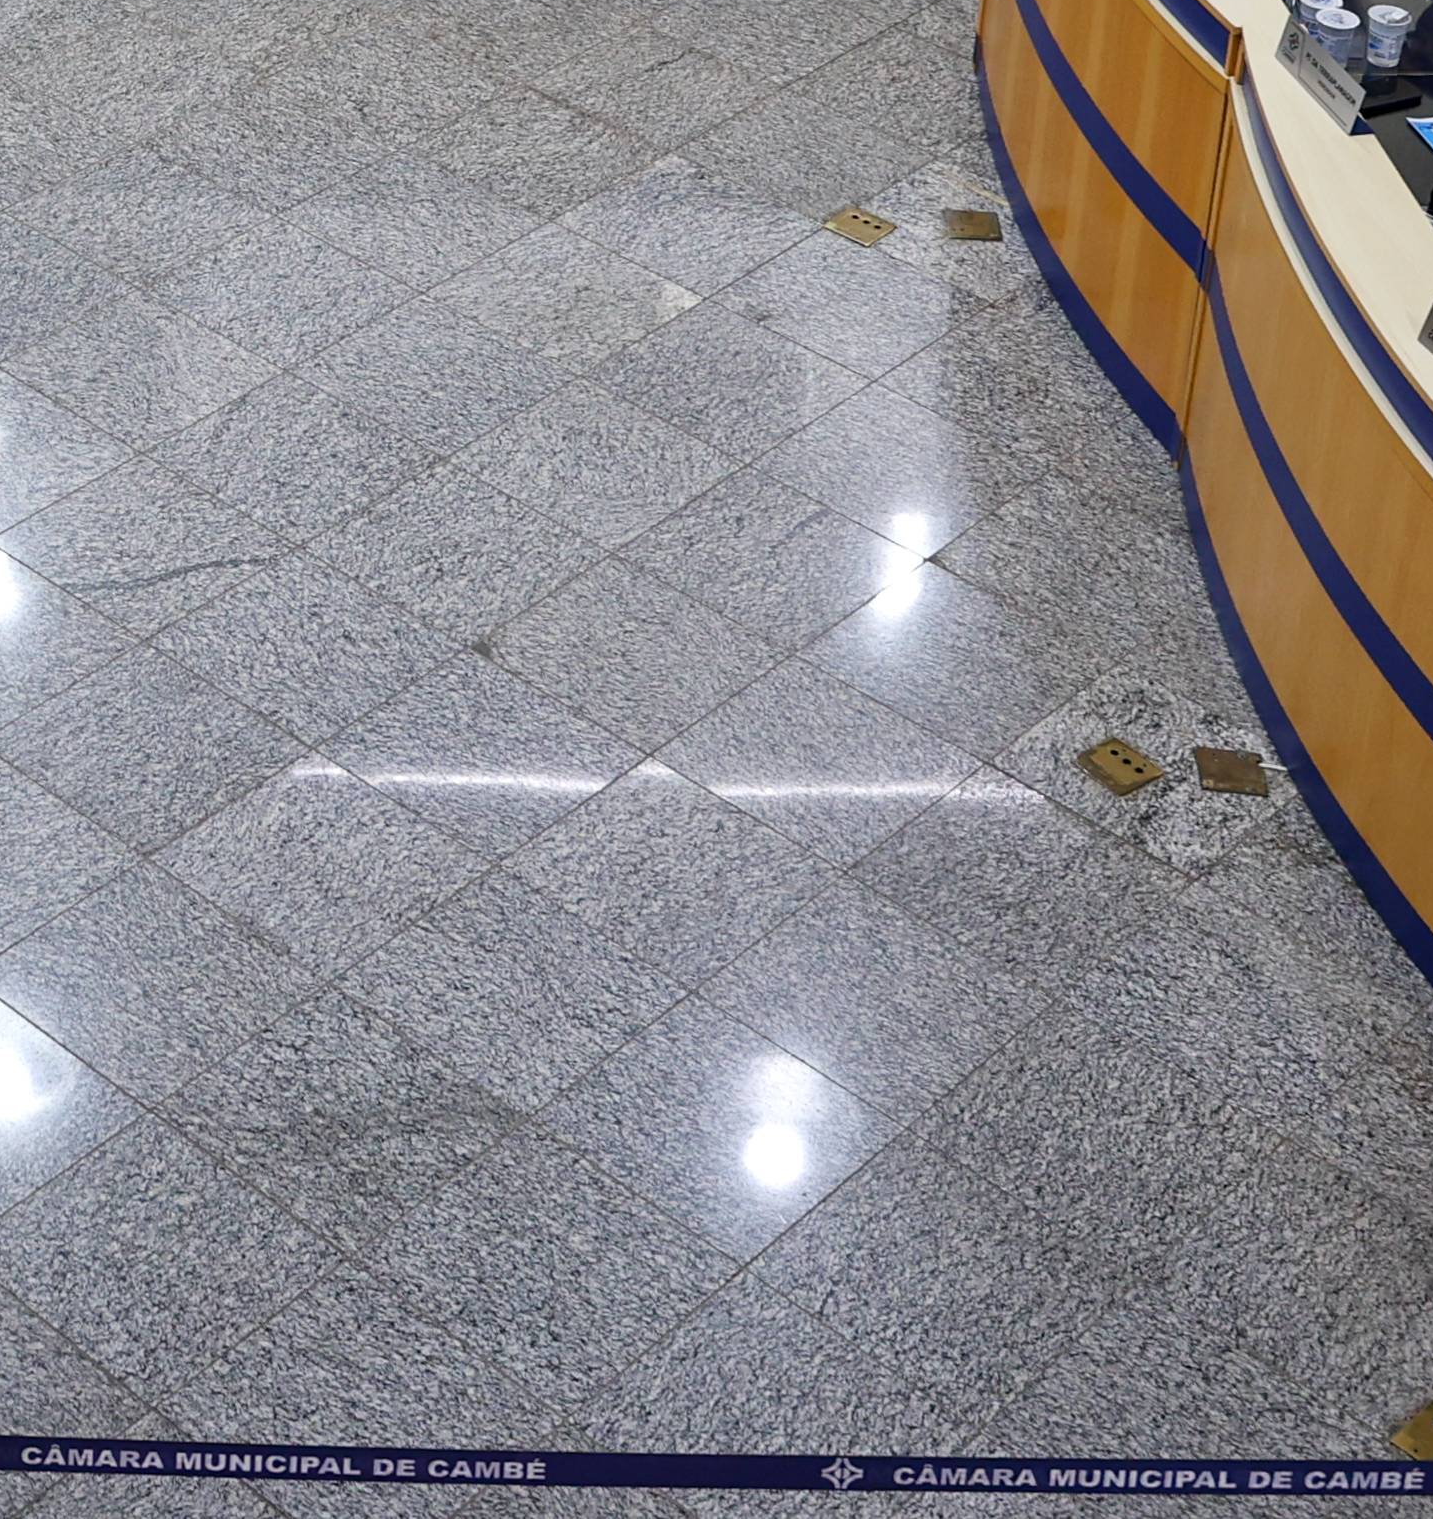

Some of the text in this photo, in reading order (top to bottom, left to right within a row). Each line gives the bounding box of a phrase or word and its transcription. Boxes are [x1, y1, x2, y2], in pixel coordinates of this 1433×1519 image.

[21, 1444, 547, 1480] CÂMARA MUNICIPAL DE CAMBÉ
[893, 1463, 1425, 1490] CÂMARA MUNICIPAL DE CAMBÉ
